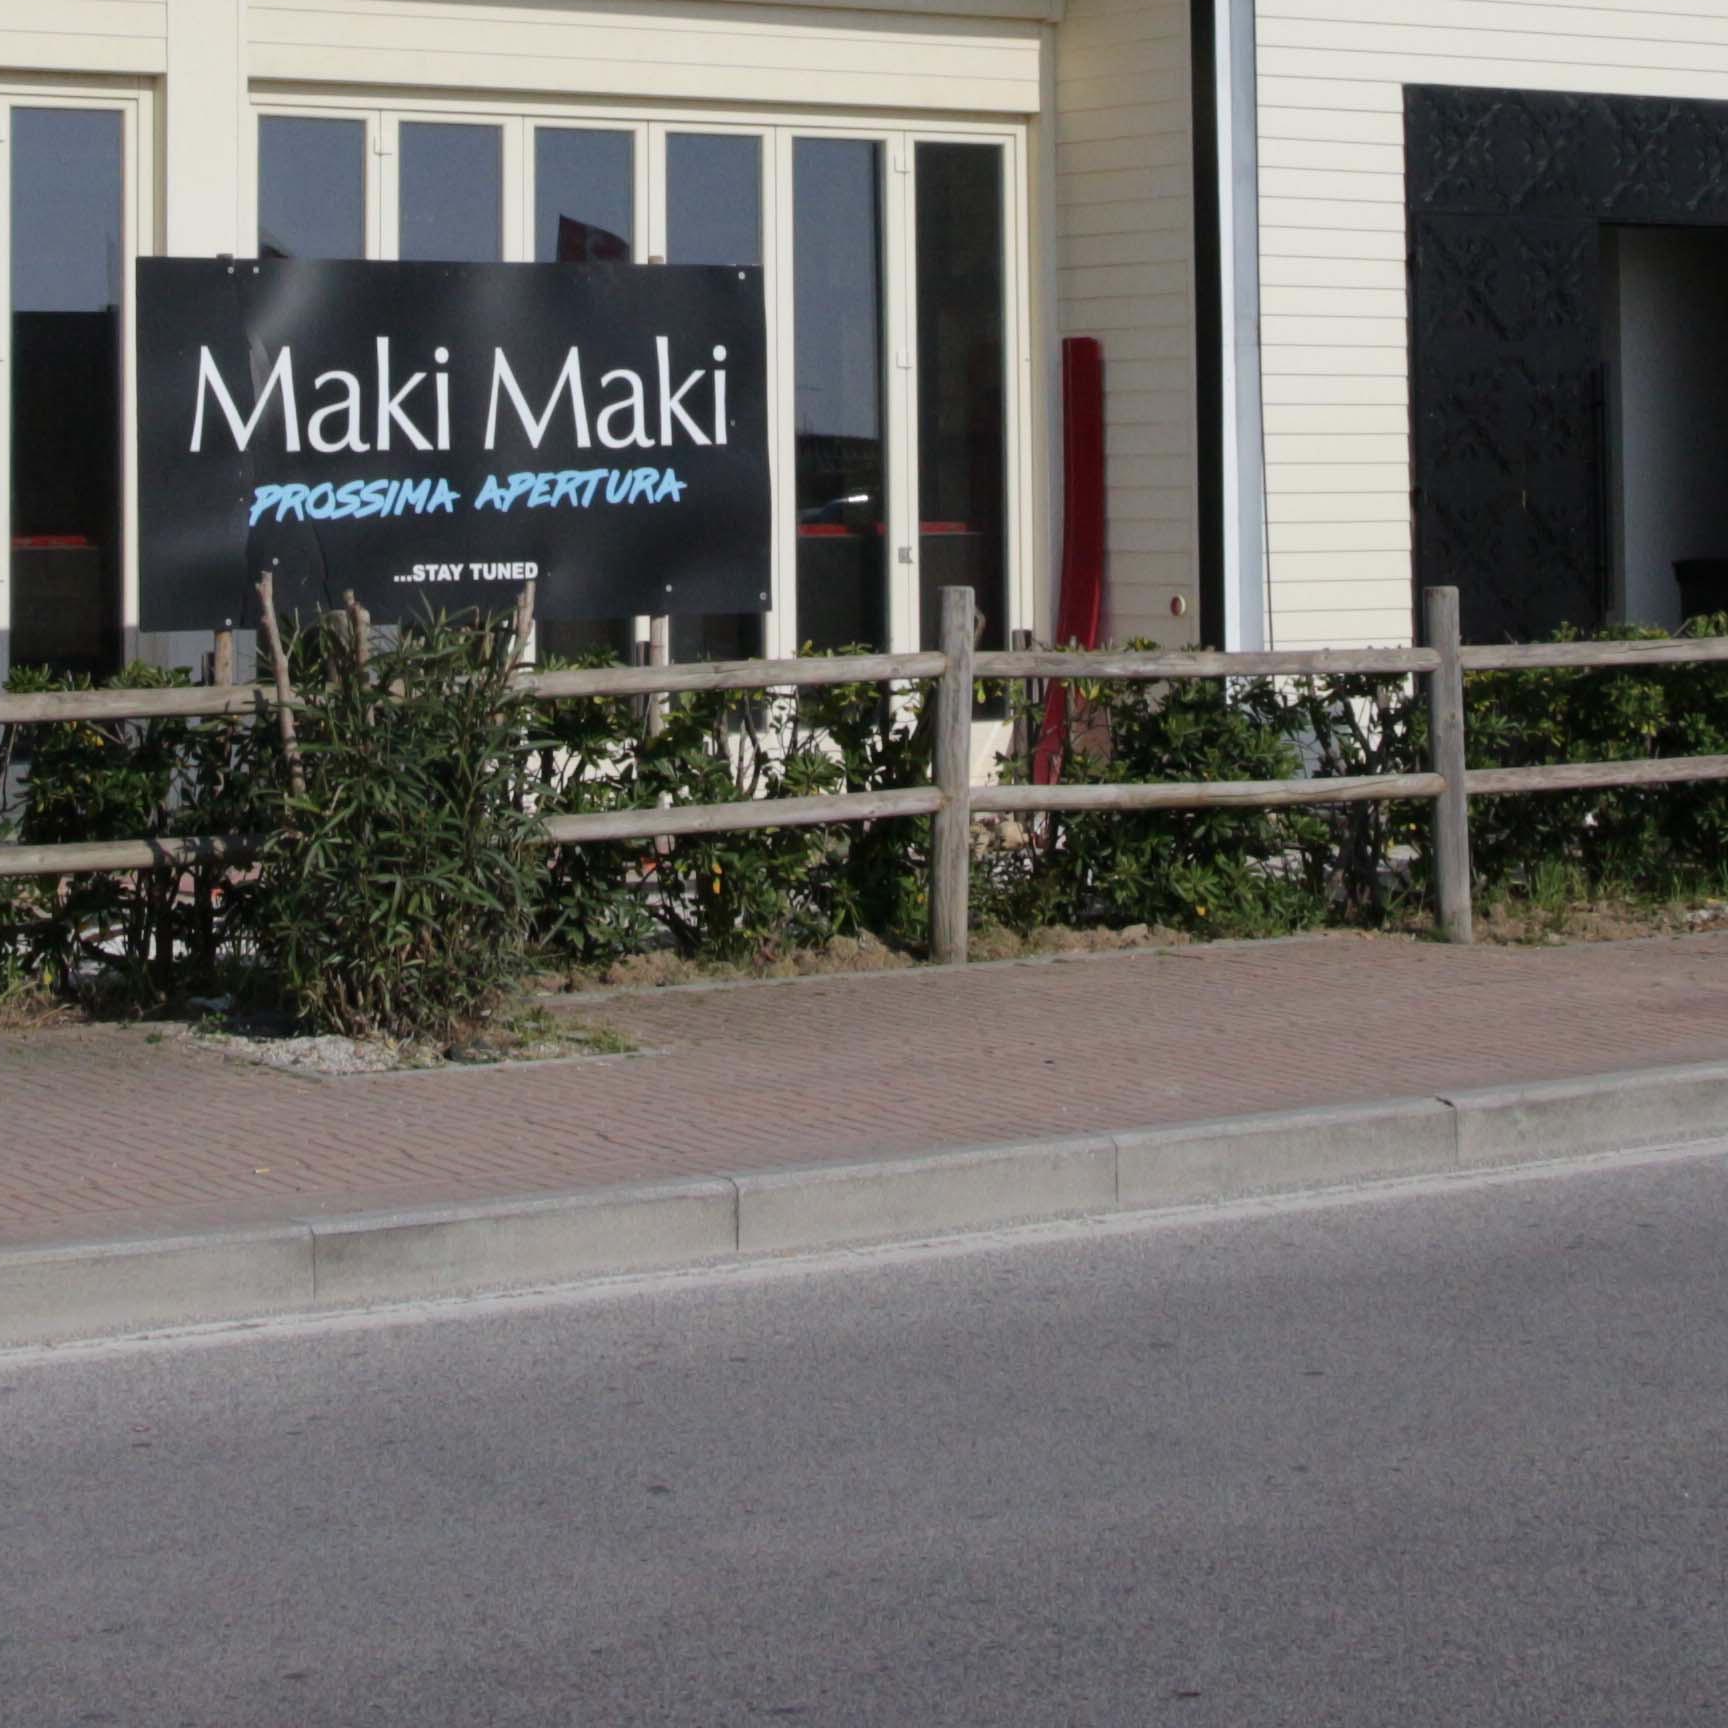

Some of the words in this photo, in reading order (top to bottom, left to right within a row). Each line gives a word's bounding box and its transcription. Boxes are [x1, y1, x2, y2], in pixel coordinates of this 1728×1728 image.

[190, 335, 450, 453] Maki
[484, 335, 728, 450] Maki
[248, 477, 460, 528] PROSSIMA
[473, 466, 688, 513] APERTURA
[468, 561, 538, 581] TUNED
